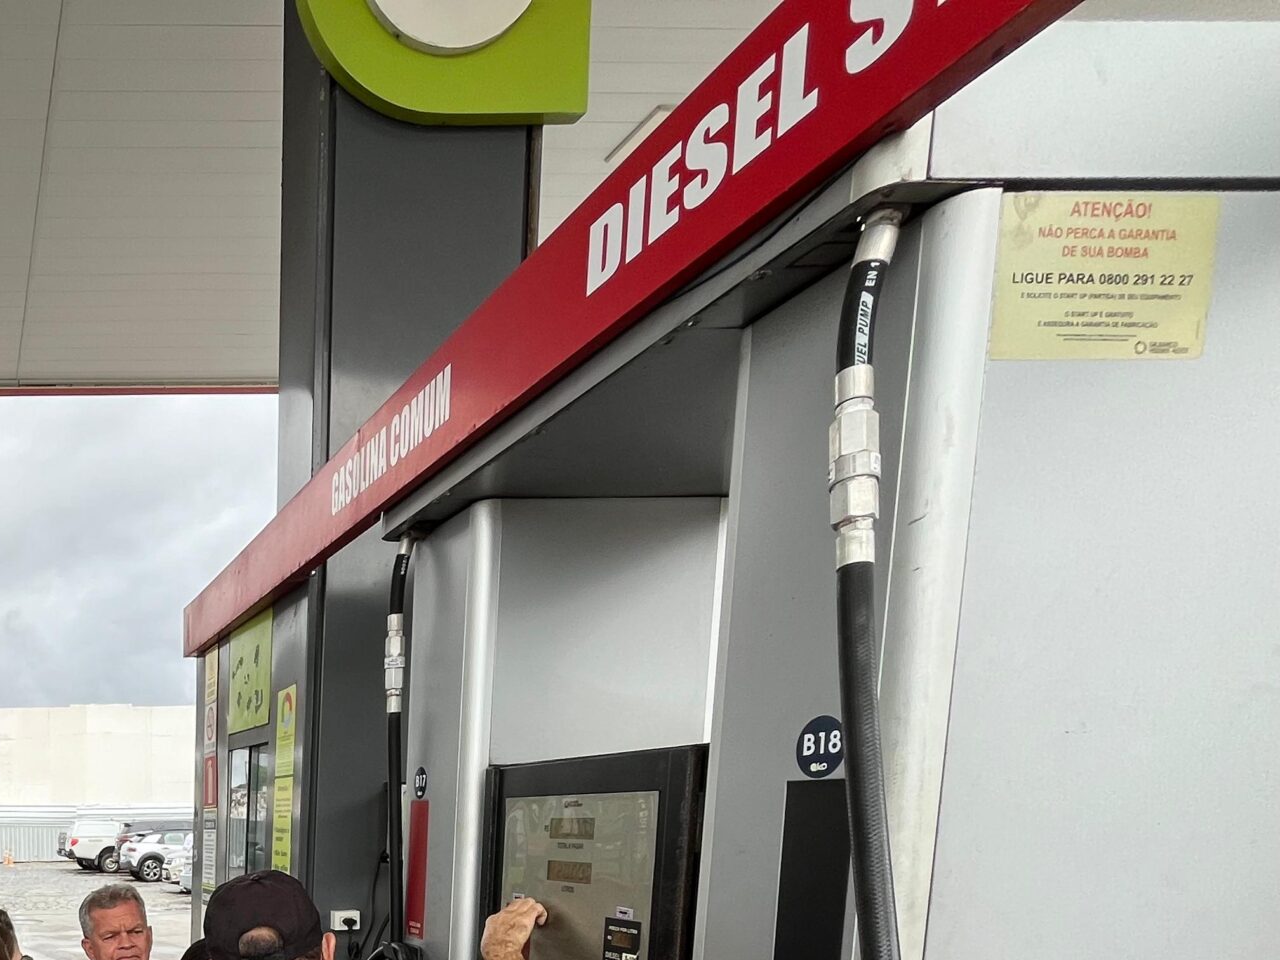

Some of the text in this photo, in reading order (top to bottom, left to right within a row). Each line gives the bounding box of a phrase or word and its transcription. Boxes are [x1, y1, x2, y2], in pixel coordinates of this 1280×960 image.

[586, 22, 819, 298] DIESEL
[1070, 199, 1153, 222] ATENÇÃO!
[1038, 224, 1177, 241] NÃO PERCA A GARANTIA
[1061, 245, 1149, 259] DE SUA BOMBA
[1012, 272, 1194, 286] LIGUE PARA 0800 291 22 27
[858, 300, 872, 336] PUMP
[865, 271, 879, 287] EN
[331, 363, 452, 516] GASOLINA COMUM
[802, 729, 842, 757] B18
[415, 774, 427, 788] B17
